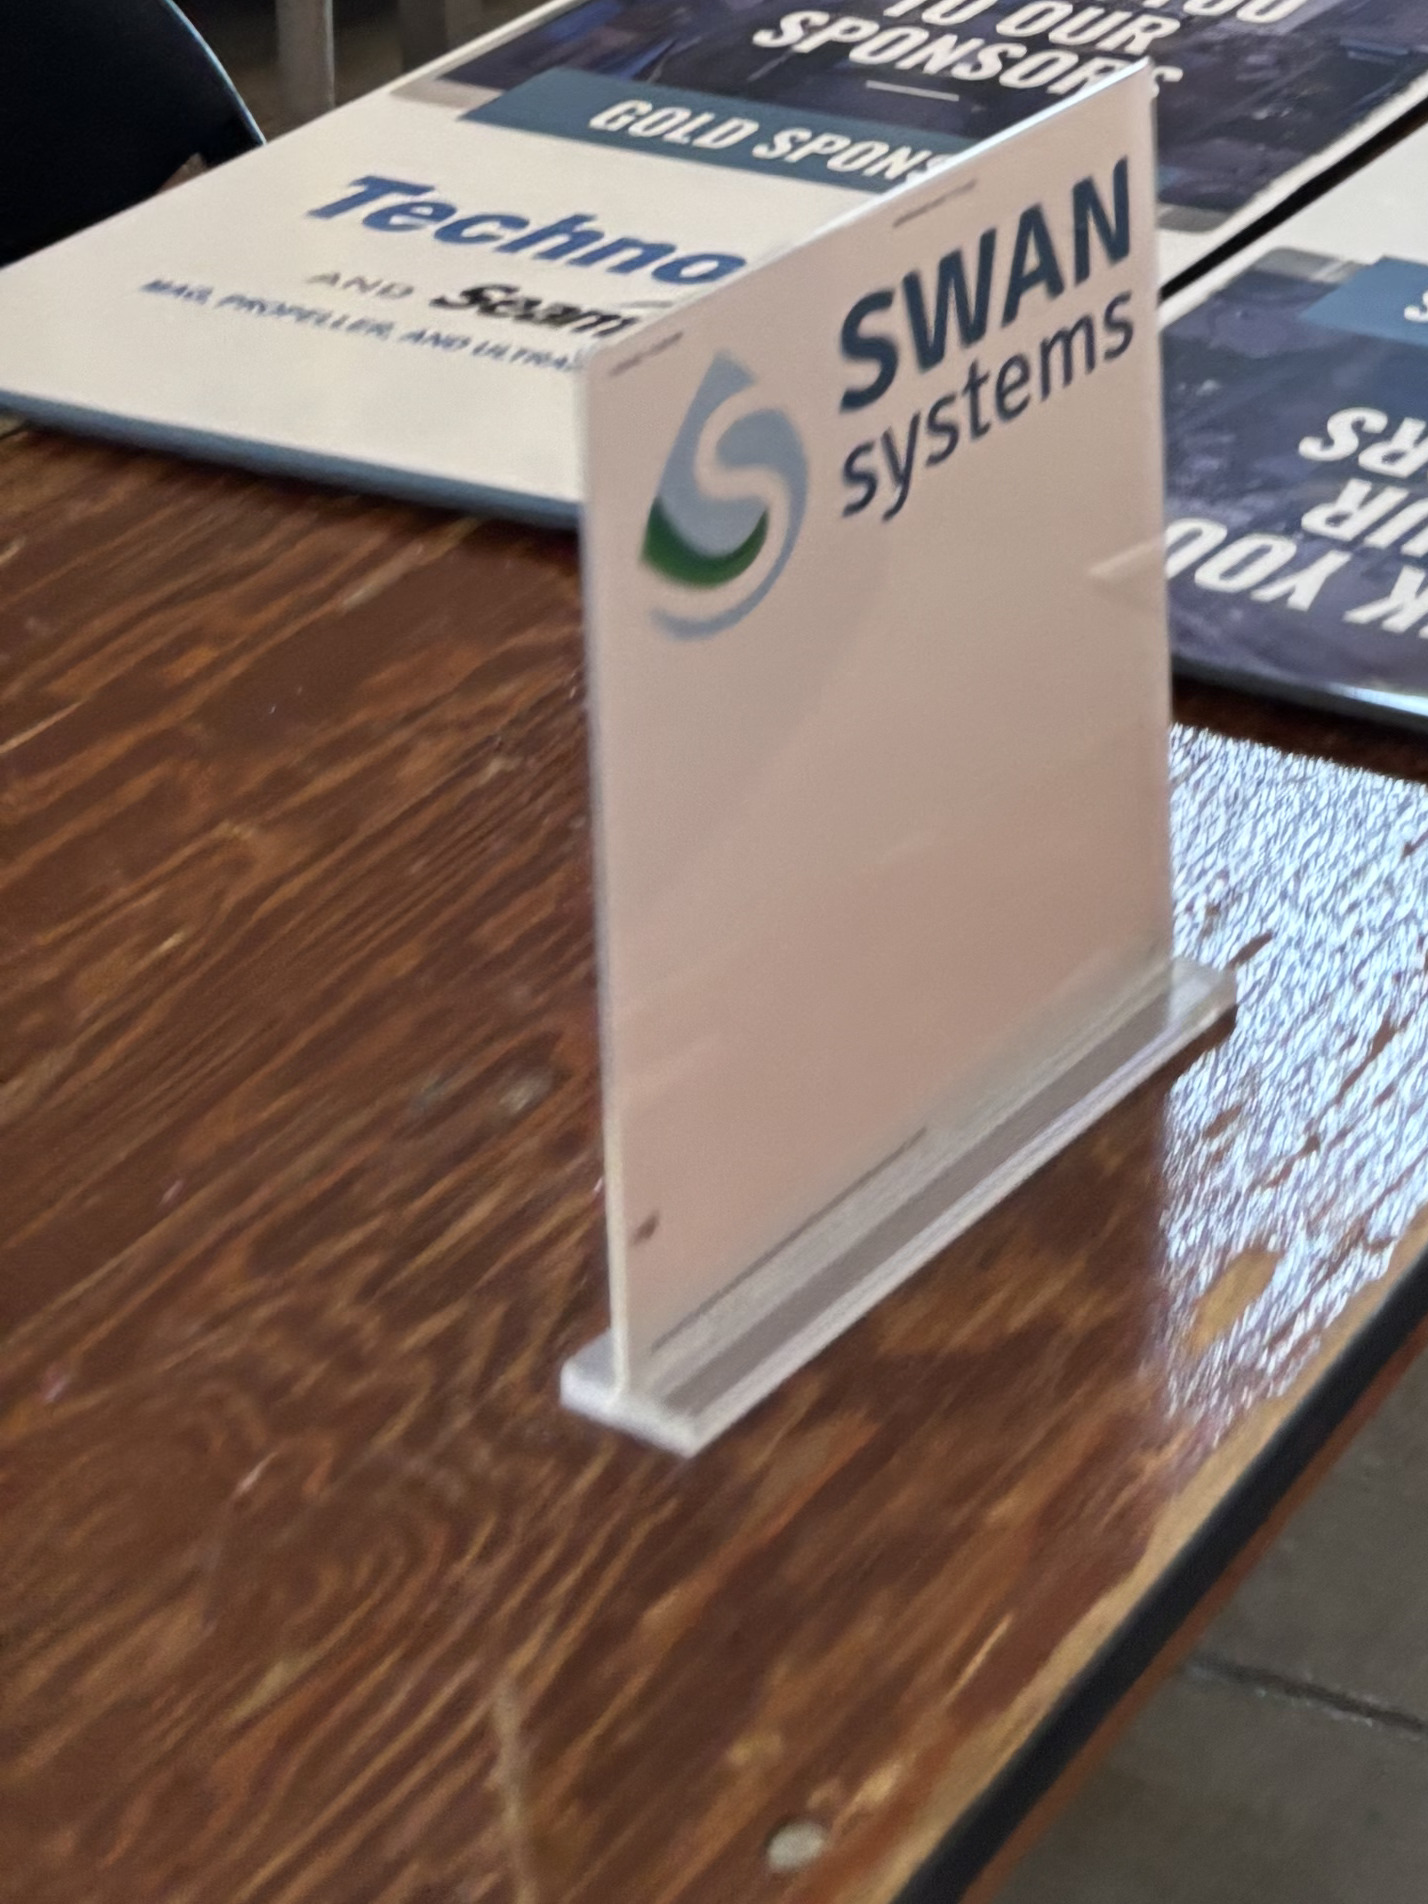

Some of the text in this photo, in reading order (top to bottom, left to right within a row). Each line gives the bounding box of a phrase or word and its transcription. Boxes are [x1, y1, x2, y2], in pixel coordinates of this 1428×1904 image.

[995, 0, 1182, 54] OUR
[588, 99, 759, 151] GOLD
[303, 173, 747, 286] Techno
[305, 270, 415, 300] AND
[838, 153, 1132, 415] SWAN
[840, 289, 1135, 524] systems
[1162, 515, 1351, 613] YOU
